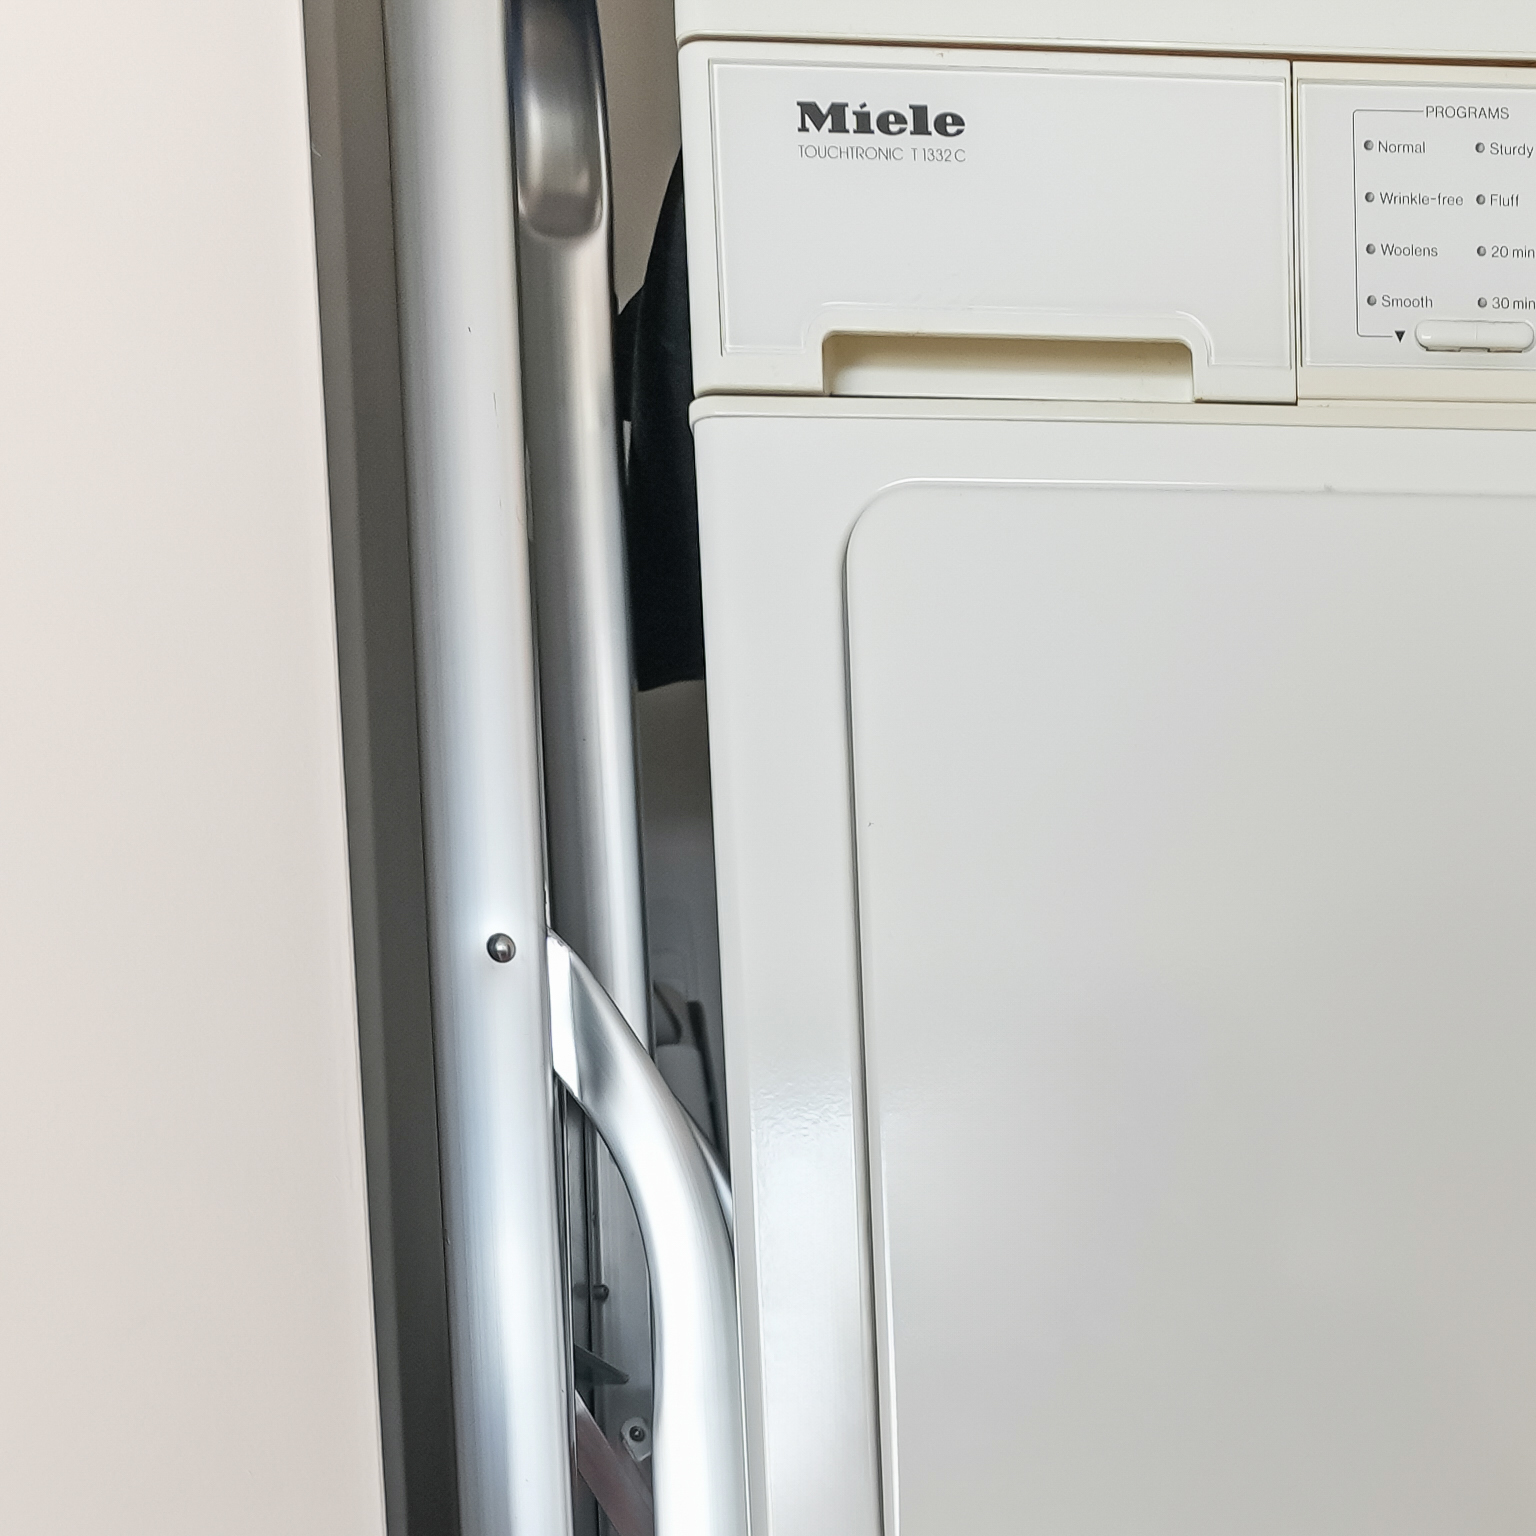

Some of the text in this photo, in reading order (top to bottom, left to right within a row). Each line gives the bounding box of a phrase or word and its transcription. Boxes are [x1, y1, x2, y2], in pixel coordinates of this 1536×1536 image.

[796, 100, 966, 138] Miele
[1425, 105, 1510, 120] PROGRAMS
[797, 144, 904, 162] TOUCHTRONIC
[910, 147, 918, 162] T
[1378, 140, 1426, 154] Normal
[1489, 141, 1534, 159] Sturdy
[1379, 191, 1464, 206] Wrinkle-free
[1490, 193, 1519, 207] Fluff
[1380, 242, 1439, 257] Woolens
[1491, 245, 1535, 259] 20 min
[1381, 294, 1433, 309] Smooth
[1491, 296, 1536, 311] 30 min
